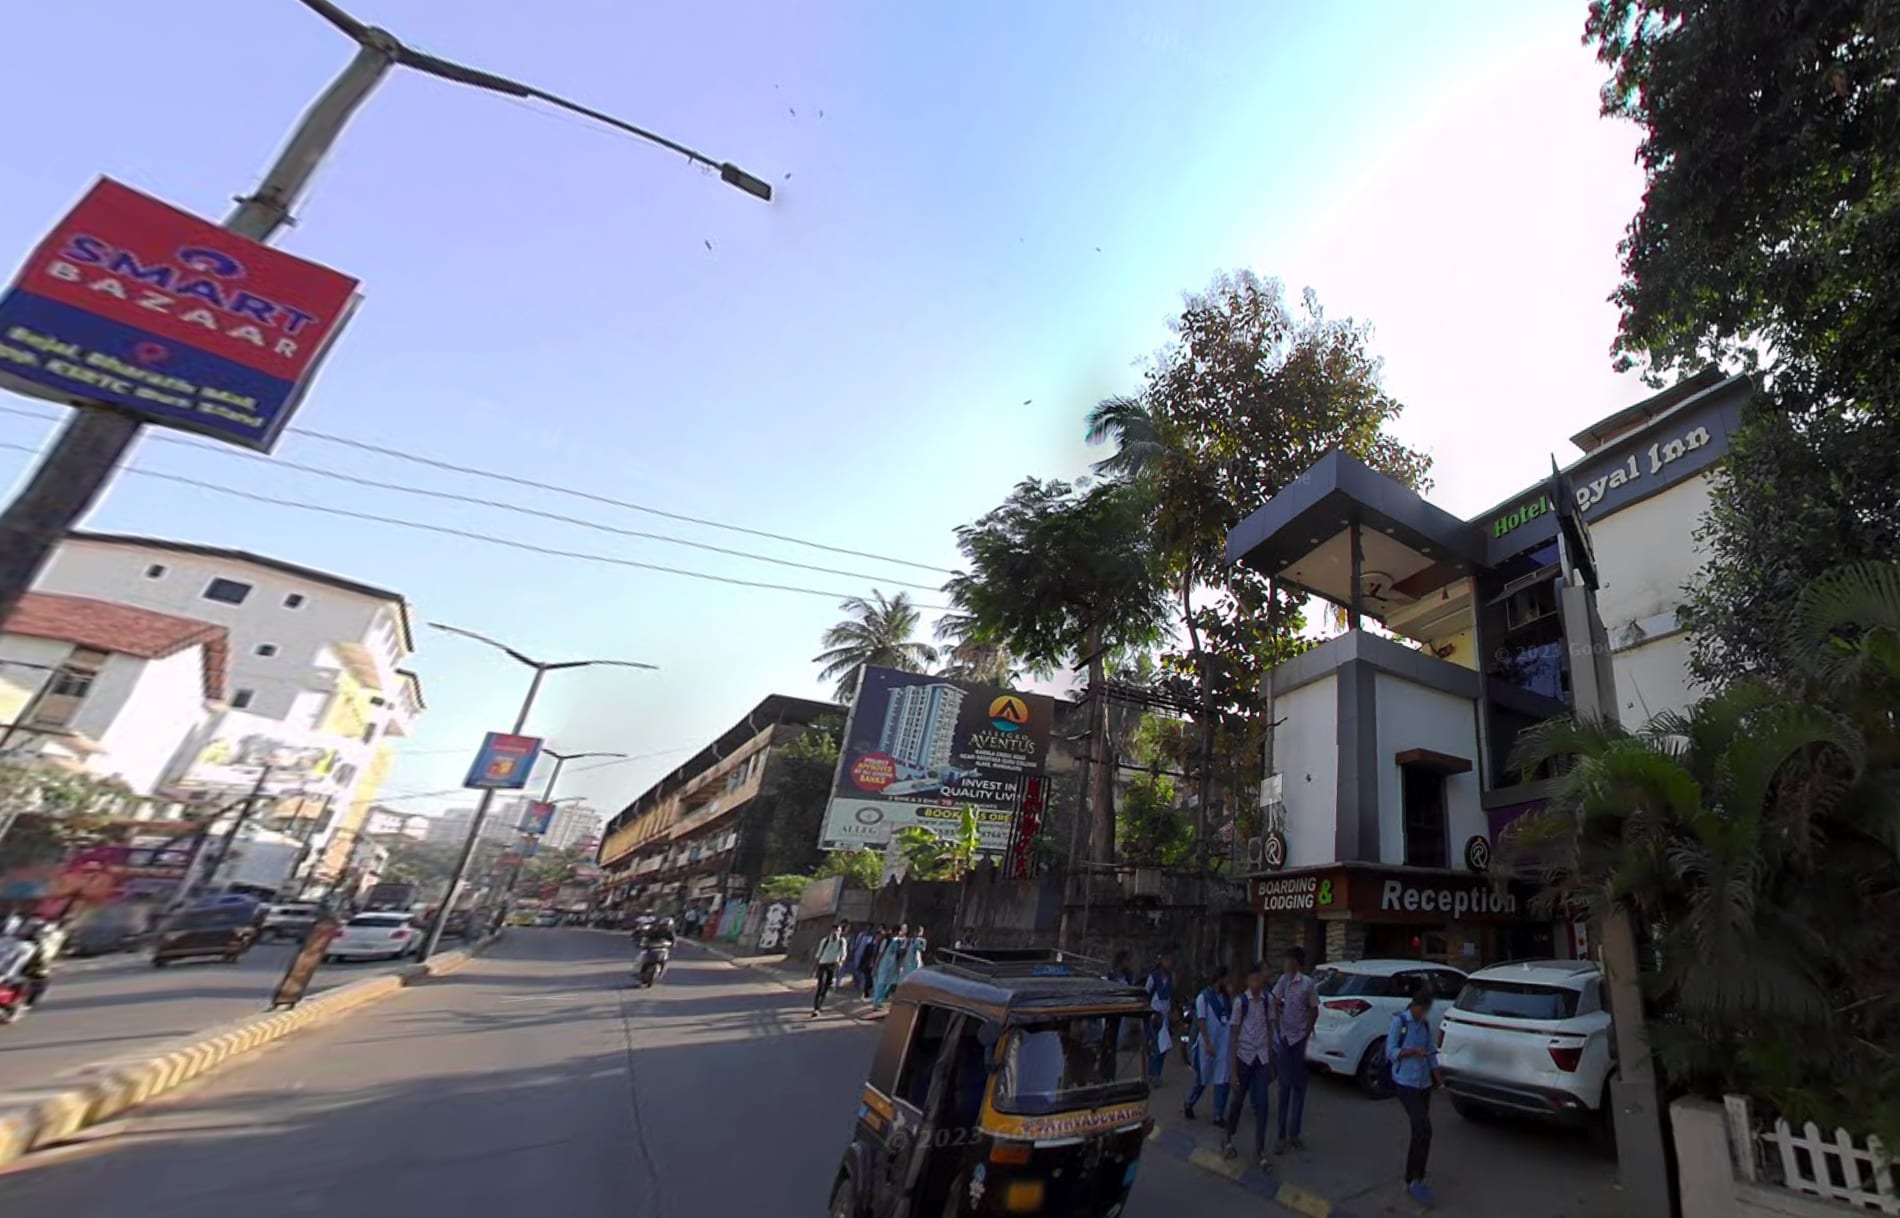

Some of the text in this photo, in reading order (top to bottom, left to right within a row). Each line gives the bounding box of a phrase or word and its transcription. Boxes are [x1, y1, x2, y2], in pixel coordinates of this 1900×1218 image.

[60, 236, 318, 333] SMART
[47, 261, 299, 358] BAZAAR
[1493, 425, 1710, 538] Hotel oyal Inn
[968, 734, 1036, 754] AVENTUS
[940, 786, 993, 800] QUALITY
[961, 778, 1017, 793] INVEST IN
[1258, 877, 1333, 905] BOARDING &
[1264, 893, 1314, 911] LODGING
[1381, 880, 1516, 918] Reception
